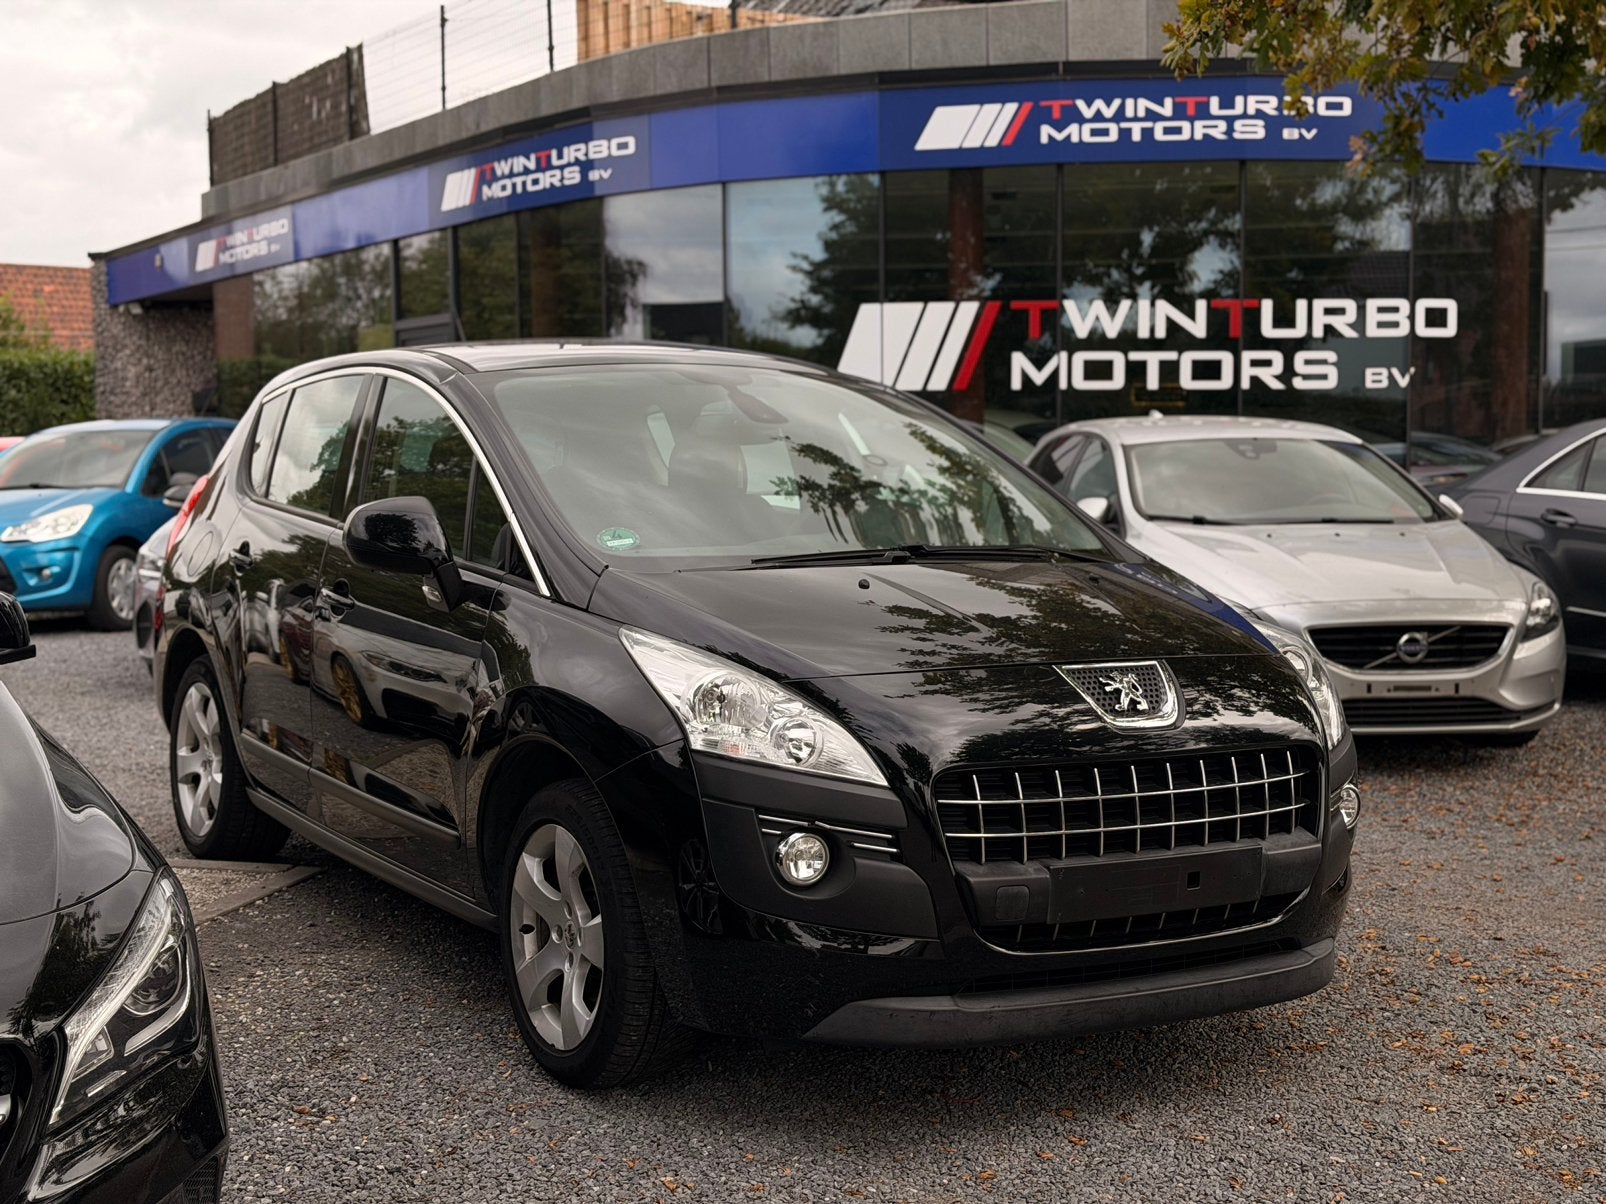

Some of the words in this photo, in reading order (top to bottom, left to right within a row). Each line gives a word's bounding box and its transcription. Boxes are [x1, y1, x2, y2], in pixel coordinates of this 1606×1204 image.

[1039, 118, 1266, 144] MOTORS
[1281, 127, 1318, 140] BV
[483, 135, 636, 180] TWINTURBO
[482, 165, 582, 201] MOTORS
[1009, 298, 1459, 339] TWINTURBO
[1010, 350, 1339, 390] MOTORS
[1364, 366, 1416, 389] BV
